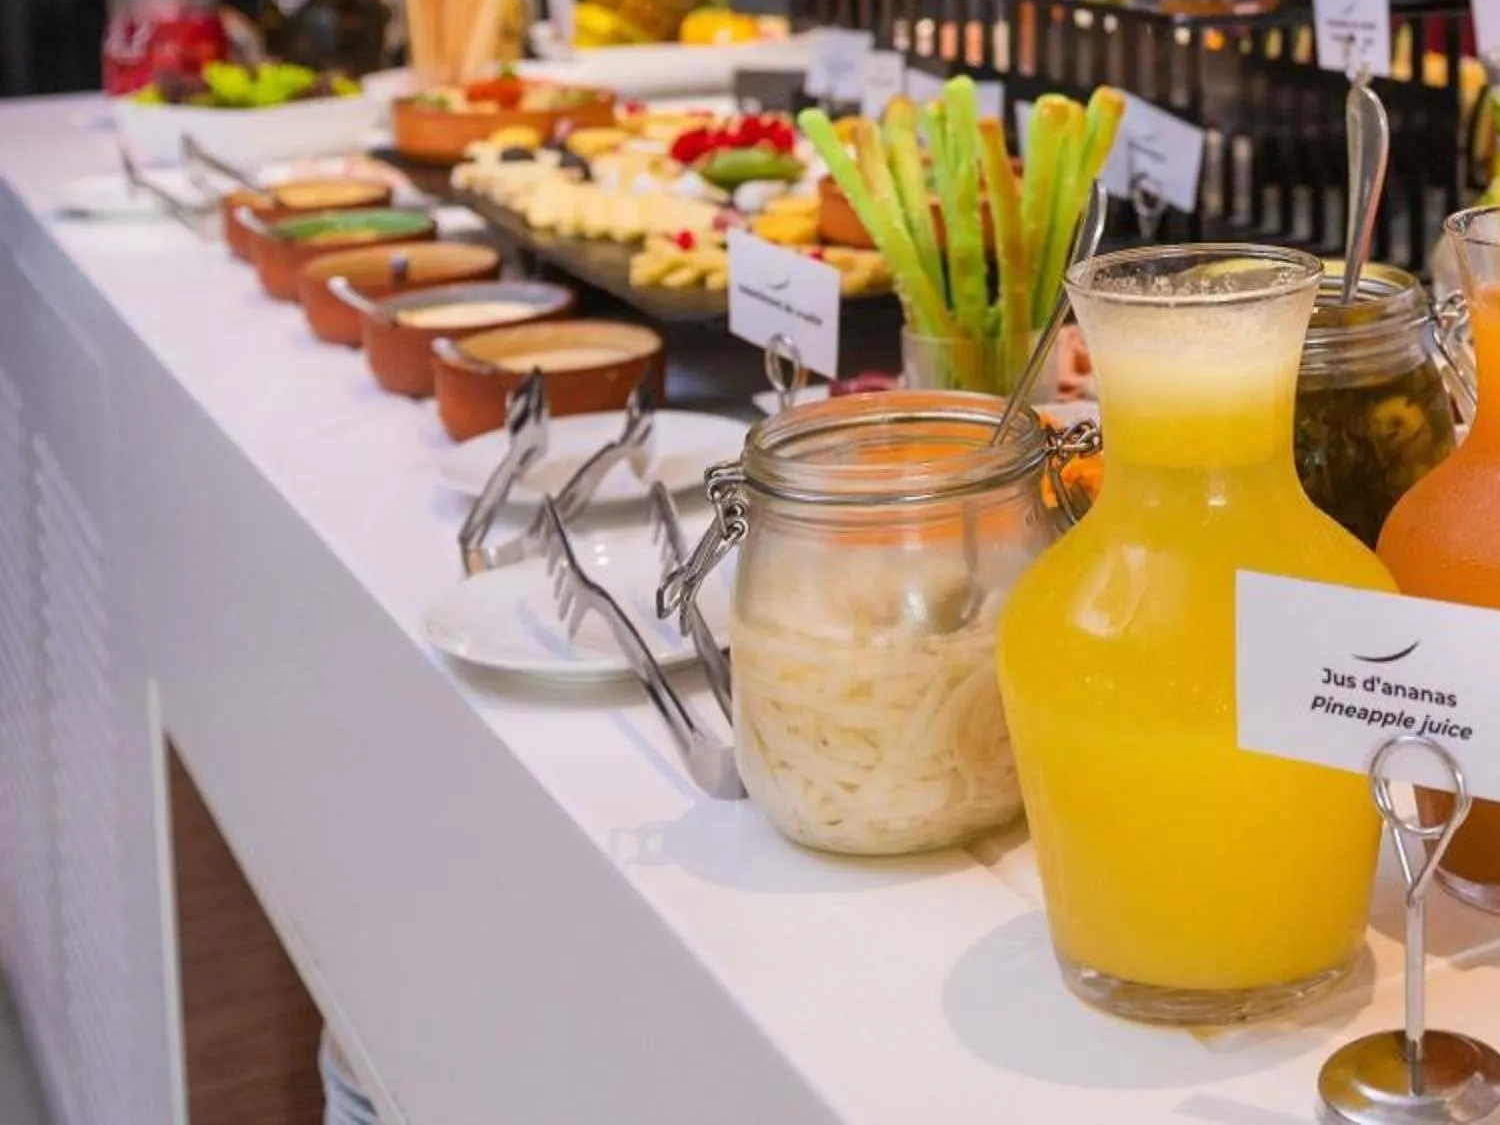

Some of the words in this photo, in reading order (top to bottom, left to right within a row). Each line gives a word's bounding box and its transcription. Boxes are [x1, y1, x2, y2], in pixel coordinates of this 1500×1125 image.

[1321, 667, 1357, 689] Jus
[1362, 675, 1458, 707] d'ananas
[1310, 695, 1416, 729] Pineapple
[1416, 714, 1473, 740] juice
